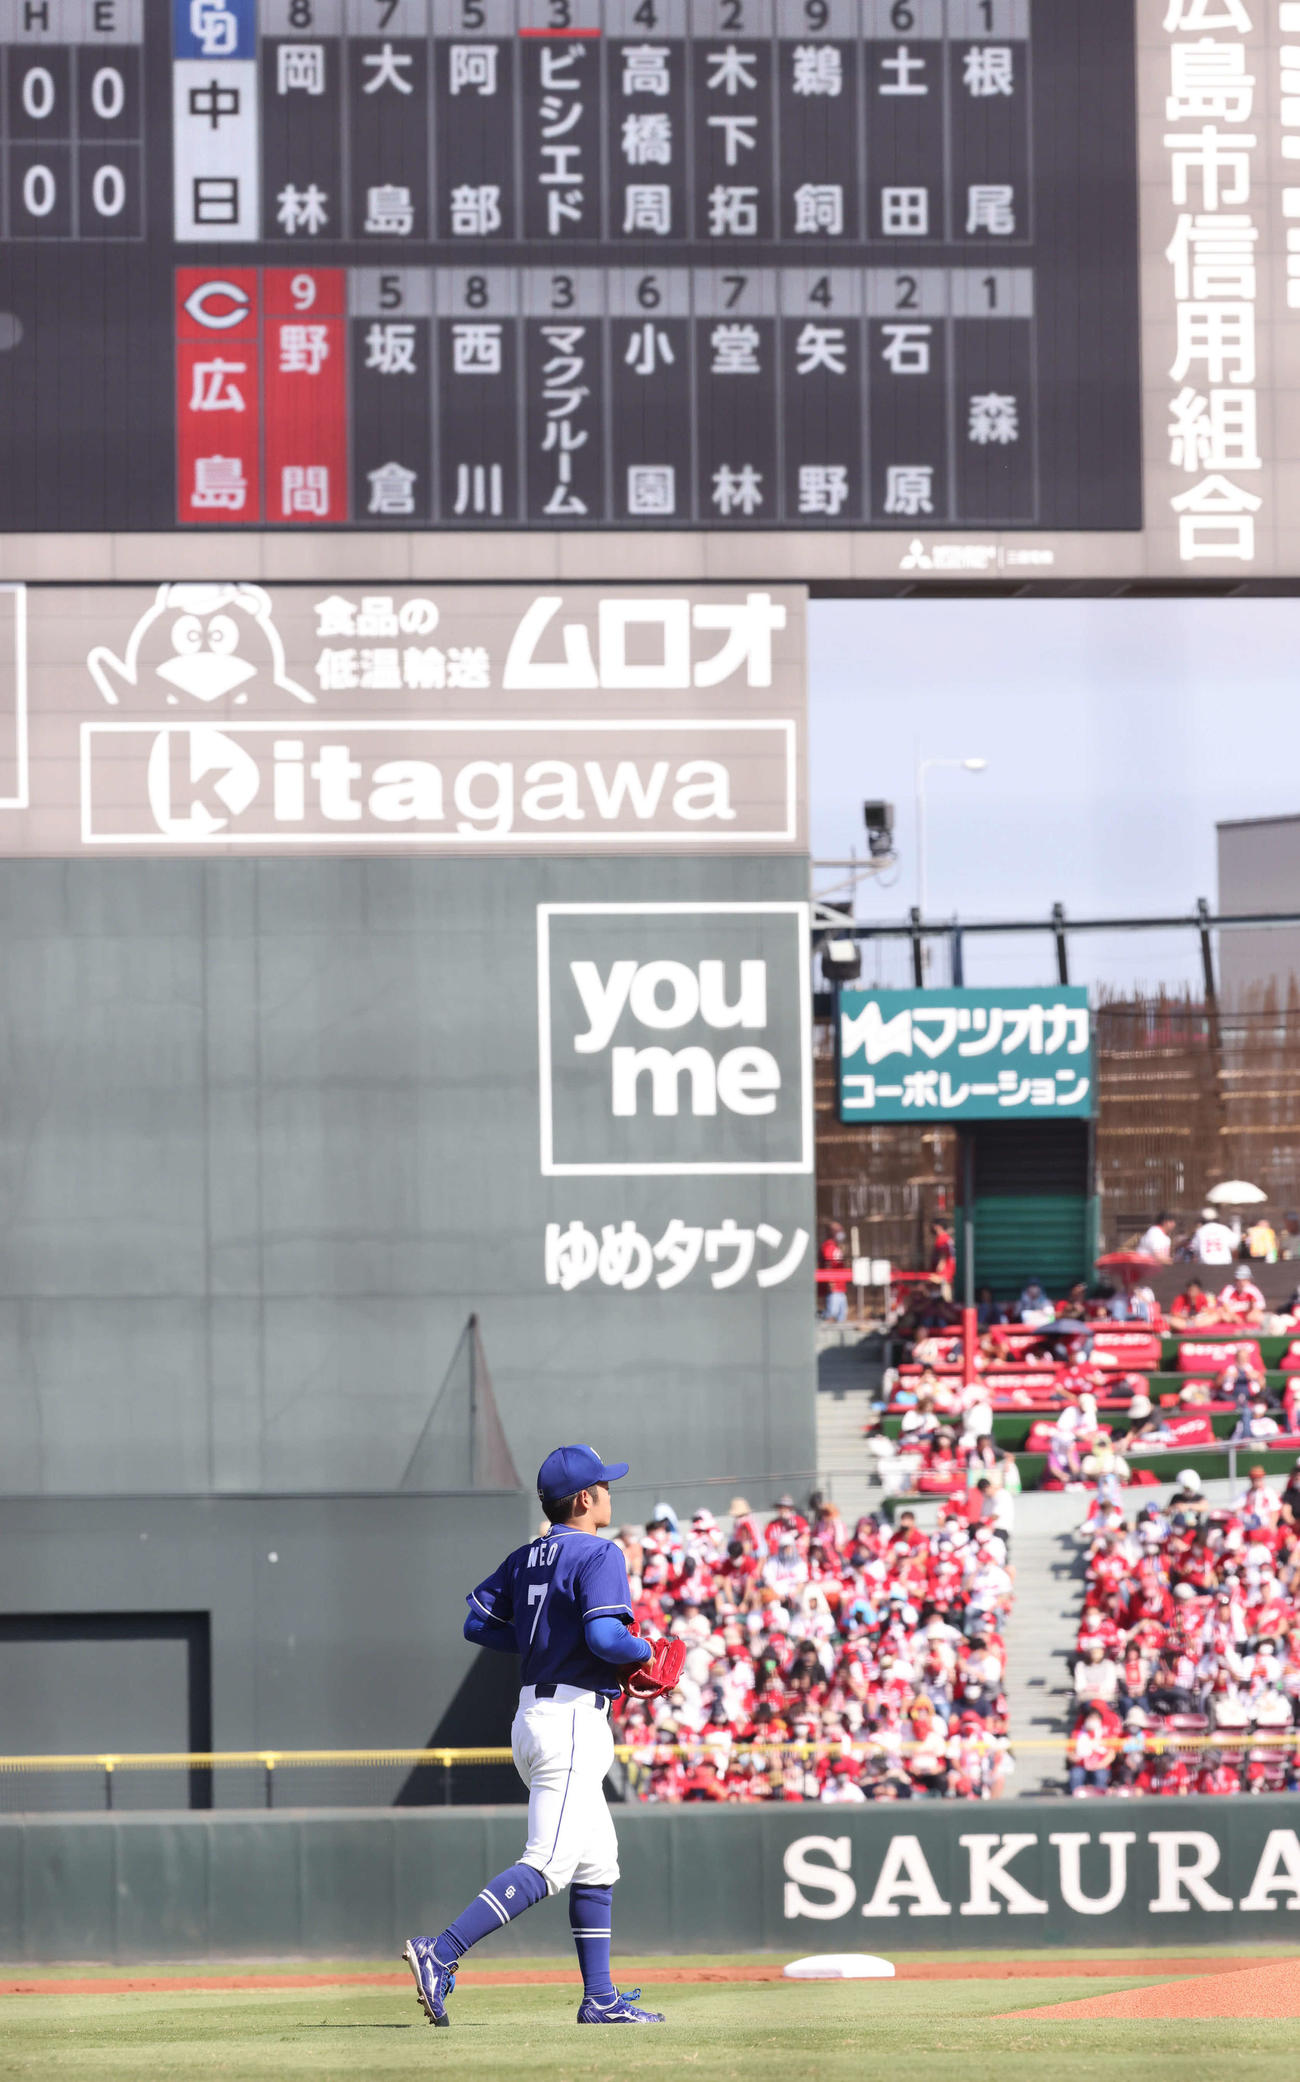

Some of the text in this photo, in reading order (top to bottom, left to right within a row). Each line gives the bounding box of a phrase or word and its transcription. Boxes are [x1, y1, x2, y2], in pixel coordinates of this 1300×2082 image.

[22, 66, 124, 119] 0 0
[23, 0, 115, 33] H E
[288, 0, 994, 29] 8 7 5 3 4 2 9 6 1
[23, 164, 125, 217] 0 0
[188, 79, 241, 226] 中日
[277, 44, 328, 235] 岡林
[363, 43, 414, 235] 大島
[449, 44, 501, 235] 阿部
[538, 44, 585, 235] ビシエド
[621, 44, 672, 235] 高橋周
[707, 45, 759, 236] 木下拓
[792, 45, 843, 235] 鵜飼
[878, 45, 929, 235] 土田
[963, 46, 1015, 235] 根尾
[290, 273, 997, 311] 9 5 8 3 6 7 4 2 1
[189, 357, 247, 511] 広島
[279, 324, 329, 516] 野間
[365, 323, 417, 514] 坂倉
[452, 324, 503, 516] 西川
[540, 325, 590, 515] マクブルーム
[624, 323, 676, 515] 小園
[710, 323, 763, 515] 堂林
[796, 323, 849, 516] 矢野
[881, 324, 934, 516] 石原
[969, 392, 1018, 445] 森
[503, 593, 786, 689] ムロオ
[569, 959, 768, 1055] you
[611, 1045, 782, 1117] me
[842, 1069, 1090, 1109] コーポレーション
[911, 1003, 1089, 1059] マツオカ
[544, 1218, 810, 1291] ゆめタウン
[527, 1542, 559, 1568] NEO
[527, 1582, 549, 1645] 7
[783, 1829, 1300, 1920] SAKURA
